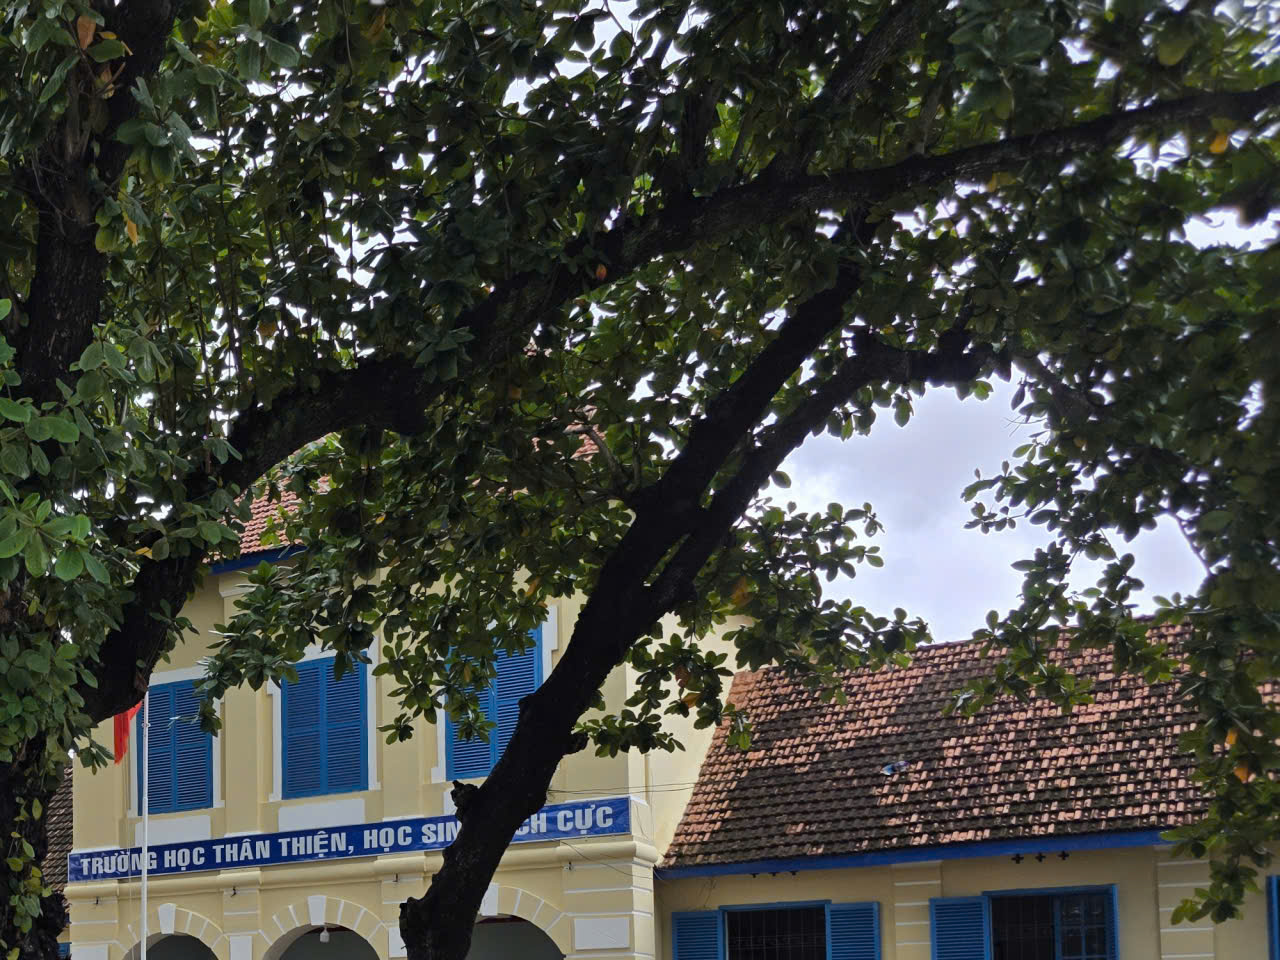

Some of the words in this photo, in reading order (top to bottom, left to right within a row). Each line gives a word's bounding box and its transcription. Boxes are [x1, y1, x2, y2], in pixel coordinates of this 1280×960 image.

[80, 850, 158, 876] TRƯỜNG
[163, 848, 205, 871] HỌC
[212, 838, 270, 864] THÂN
[278, 830, 355, 858] THIỆN,
[363, 826, 412, 852] HỌC
[421, 820, 462, 844] SIN
[557, 804, 613, 834] CỰC
